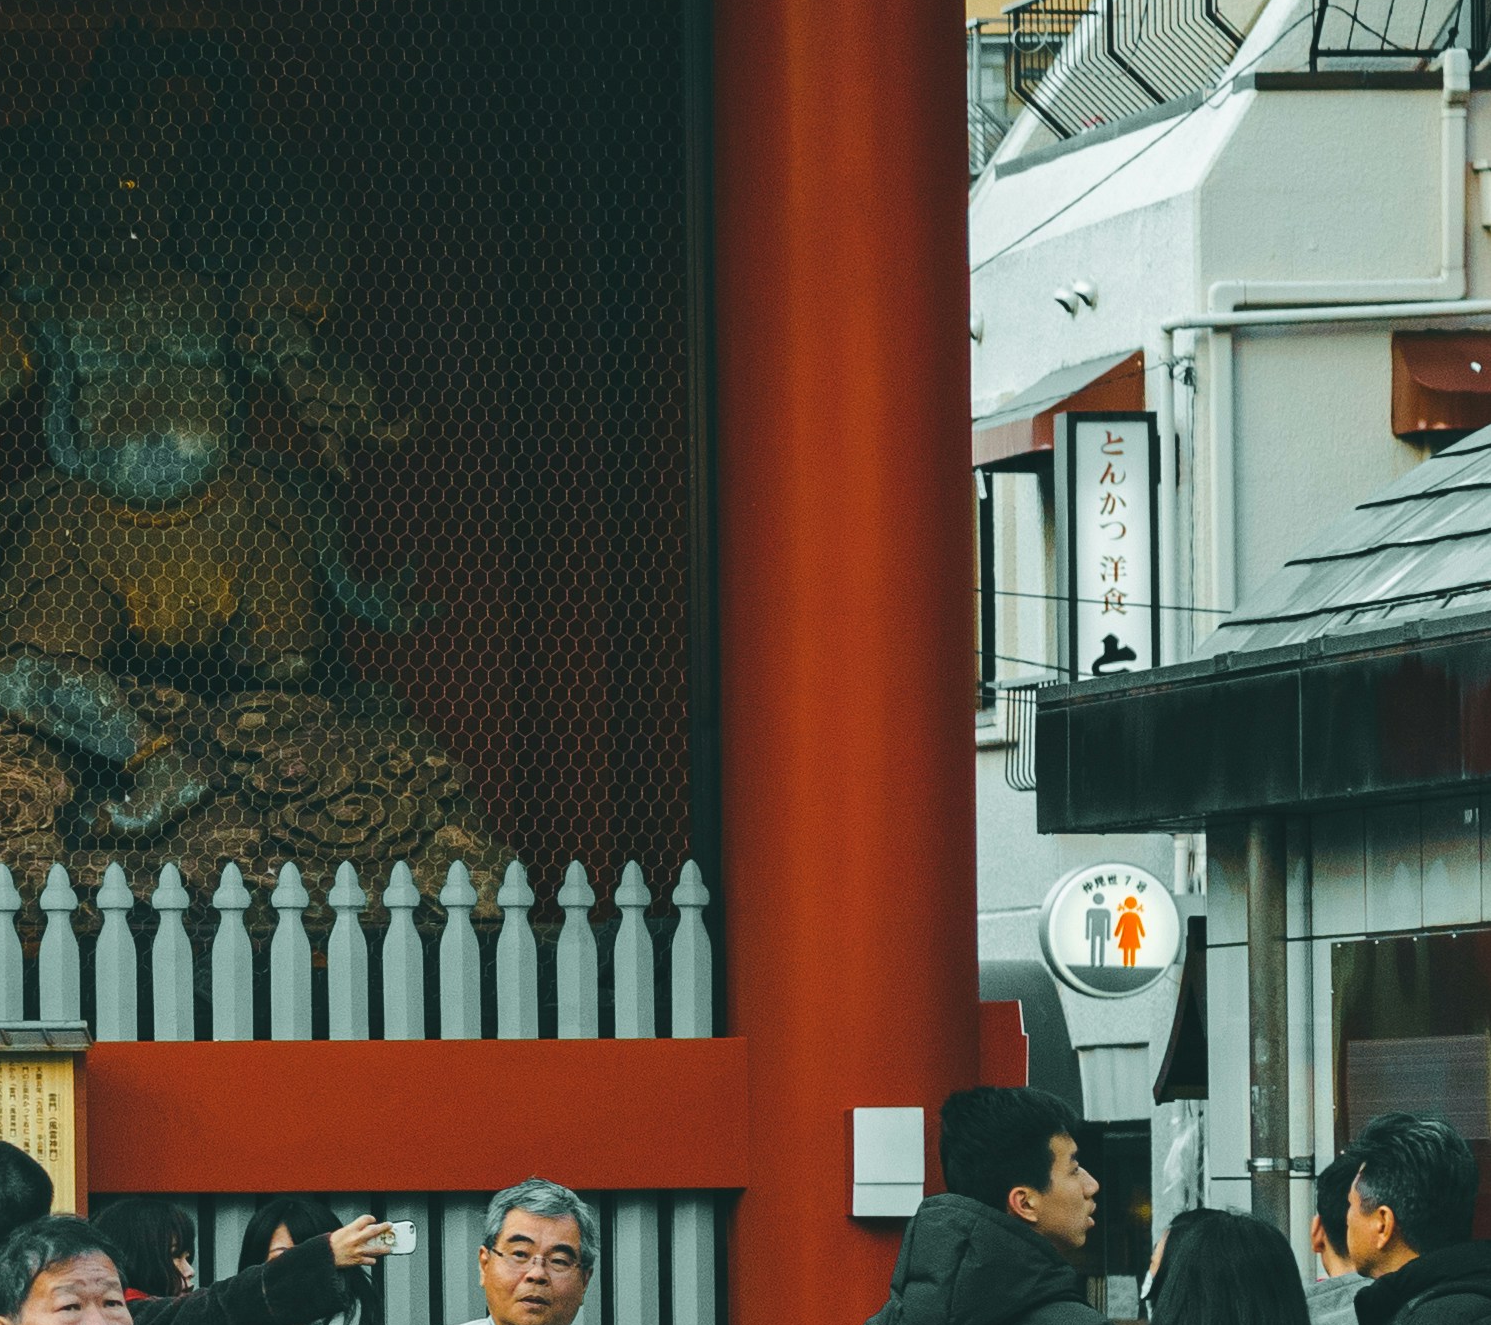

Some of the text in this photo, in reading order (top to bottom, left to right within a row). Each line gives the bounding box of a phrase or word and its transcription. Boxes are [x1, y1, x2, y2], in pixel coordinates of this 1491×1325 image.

[1100, 430, 1128, 616] とんかつ 洋食
